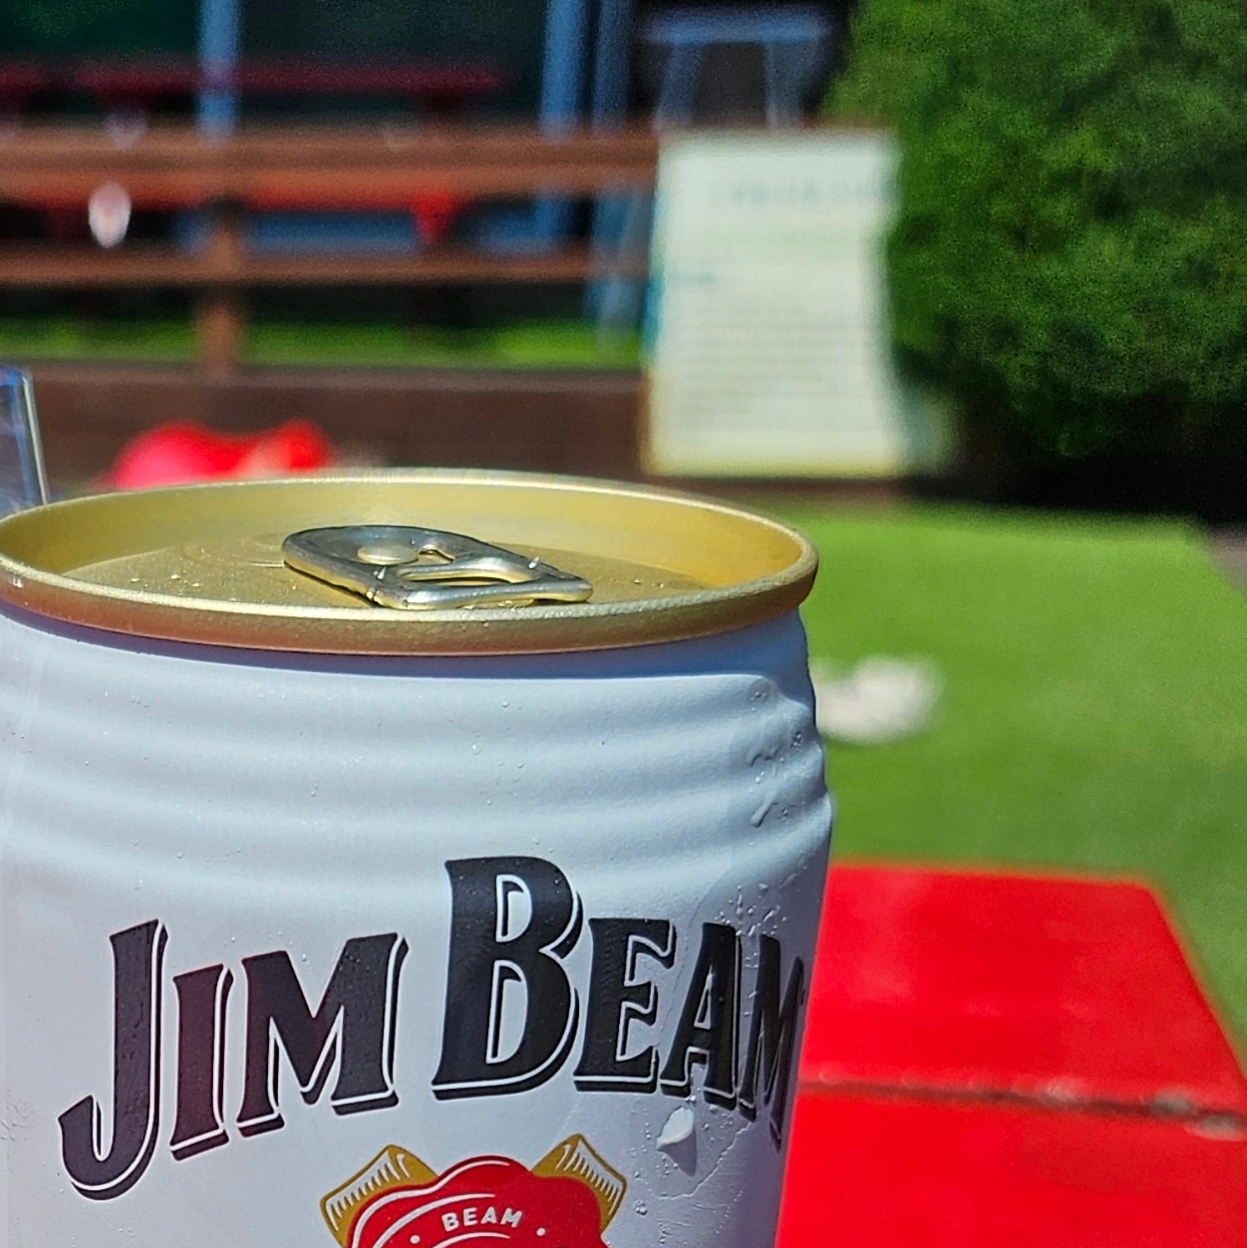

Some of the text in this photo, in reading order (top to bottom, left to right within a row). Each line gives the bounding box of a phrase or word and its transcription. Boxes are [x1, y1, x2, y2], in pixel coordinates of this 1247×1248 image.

[57, 917, 409, 1202] JIM
[432, 855, 808, 1150] BEAM
[442, 1206, 523, 1233] BEAM
